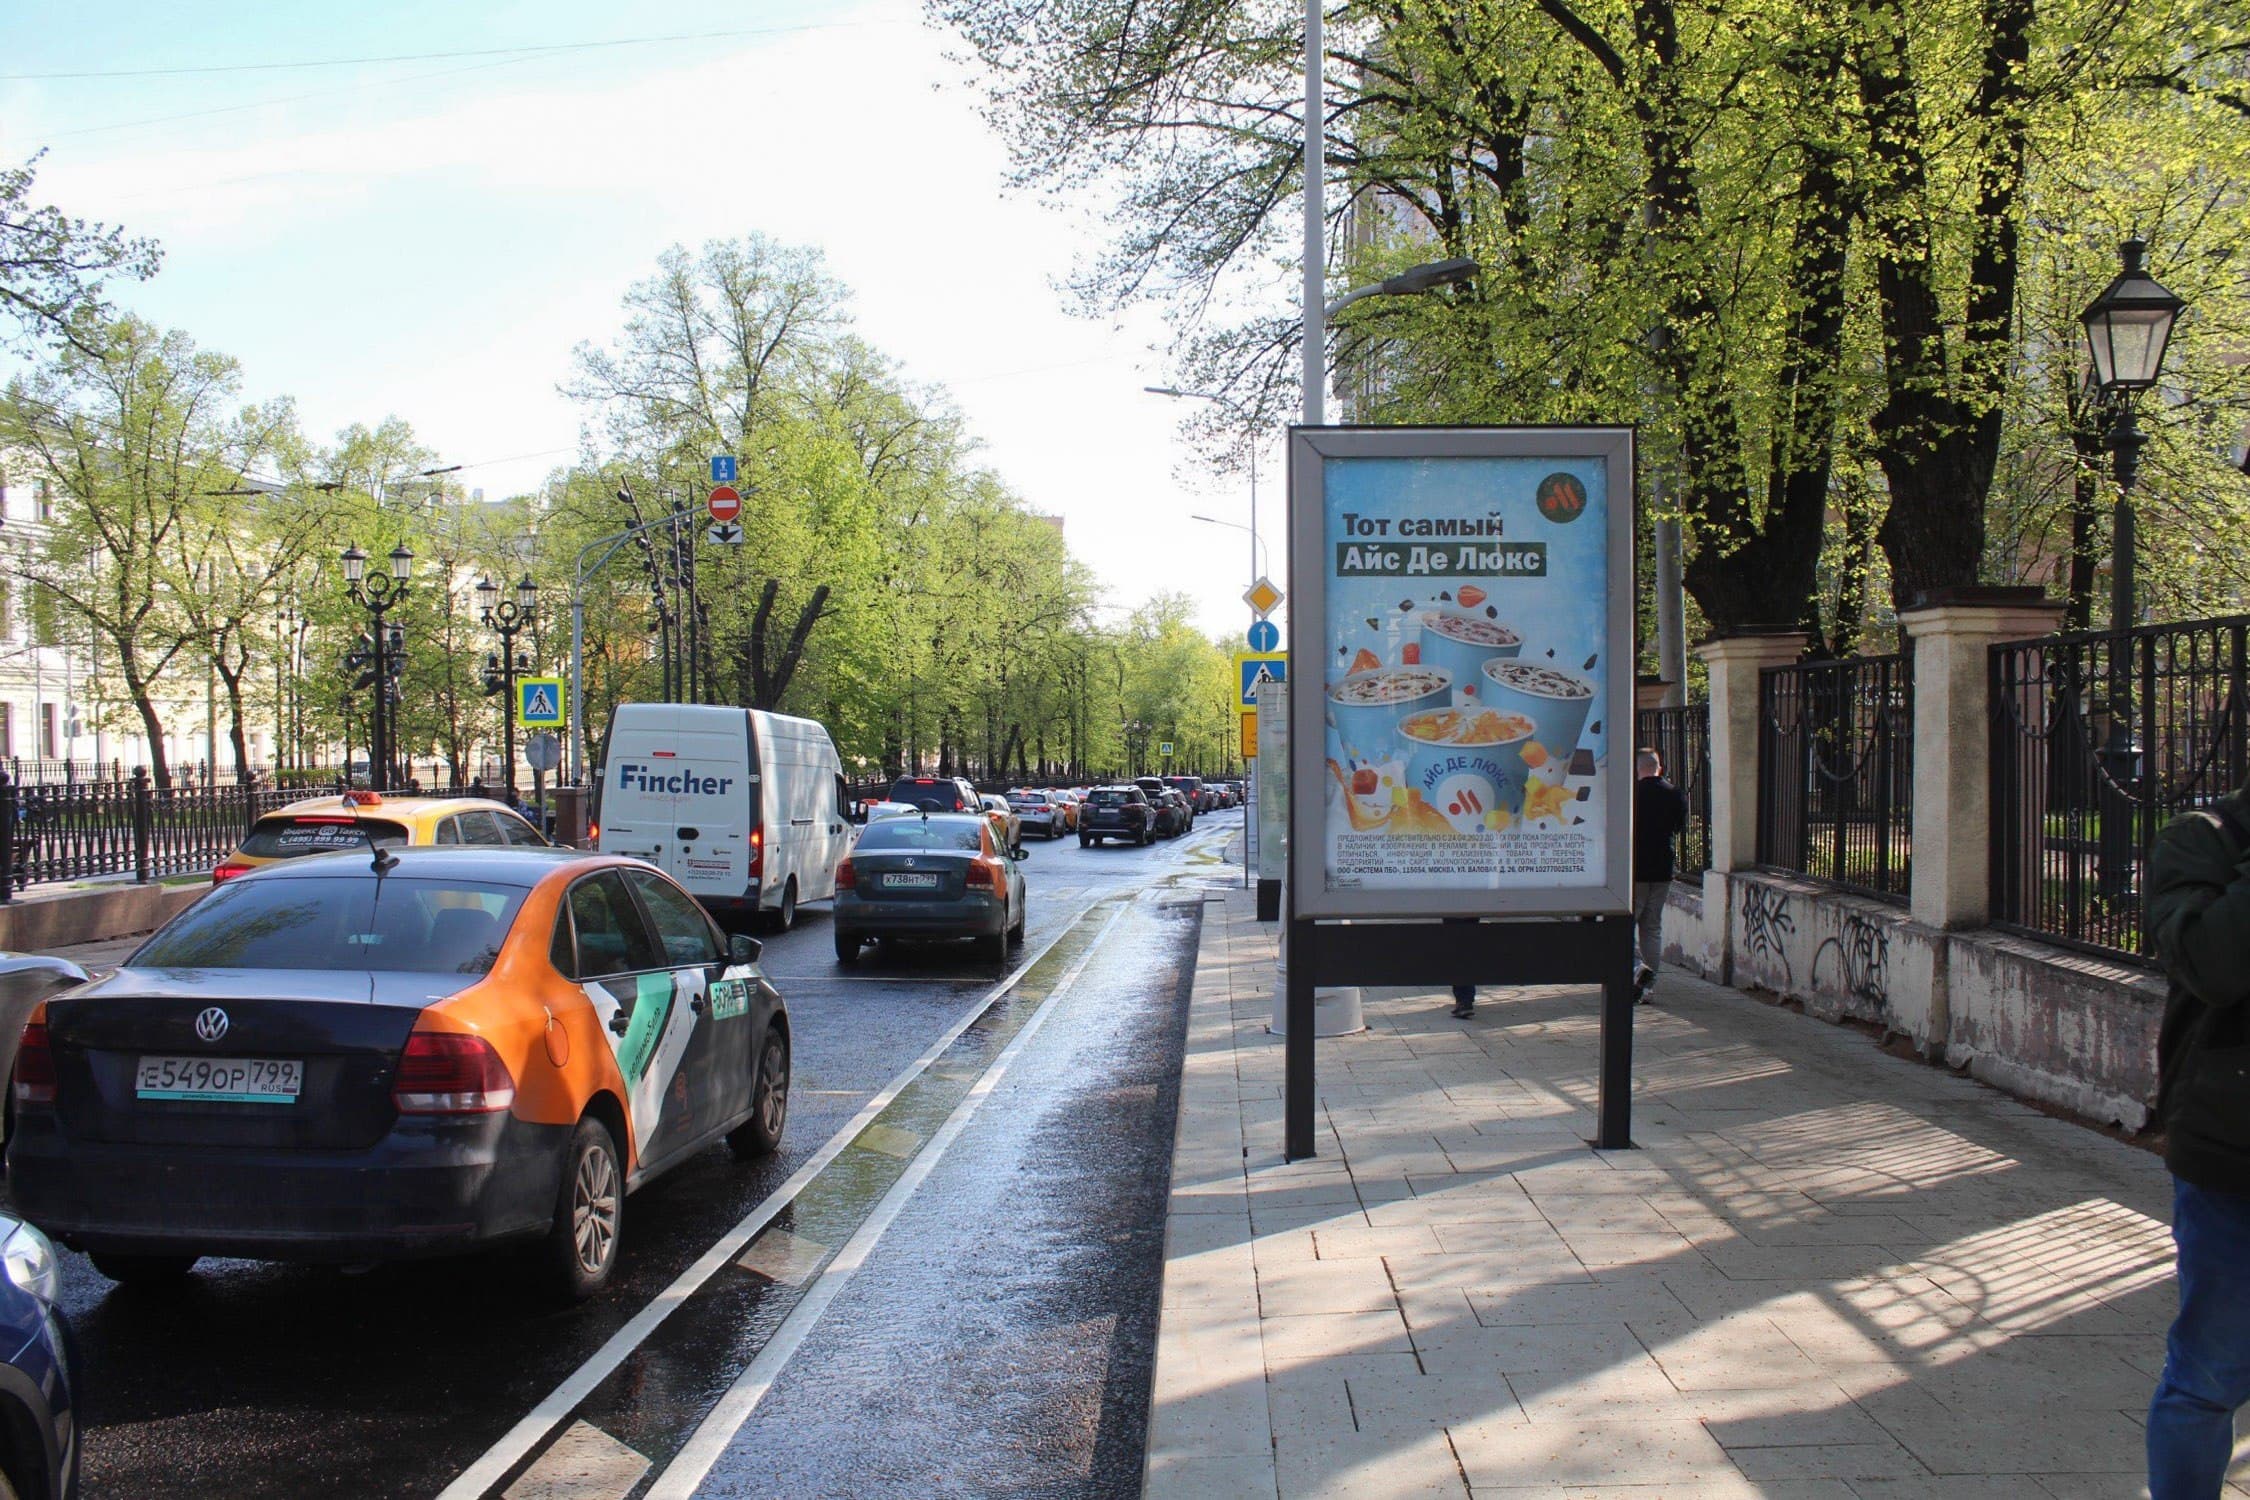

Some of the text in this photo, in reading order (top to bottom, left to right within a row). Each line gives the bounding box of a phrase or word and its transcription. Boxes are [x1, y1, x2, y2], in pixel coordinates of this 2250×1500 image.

[1343, 512, 1503, 536] Тот самый
[1343, 545, 1540, 574] Айс Де Люкс
[620, 764, 733, 795] Fincher
[1423, 763, 1445, 790] АЙС
[1446, 756, 1468, 772] ДЕ
[1337, 866, 1351, 874] ООО
[144, 1061, 295, 1089] Е549ОР 799
[261, 1083, 282, 1093] RUS
